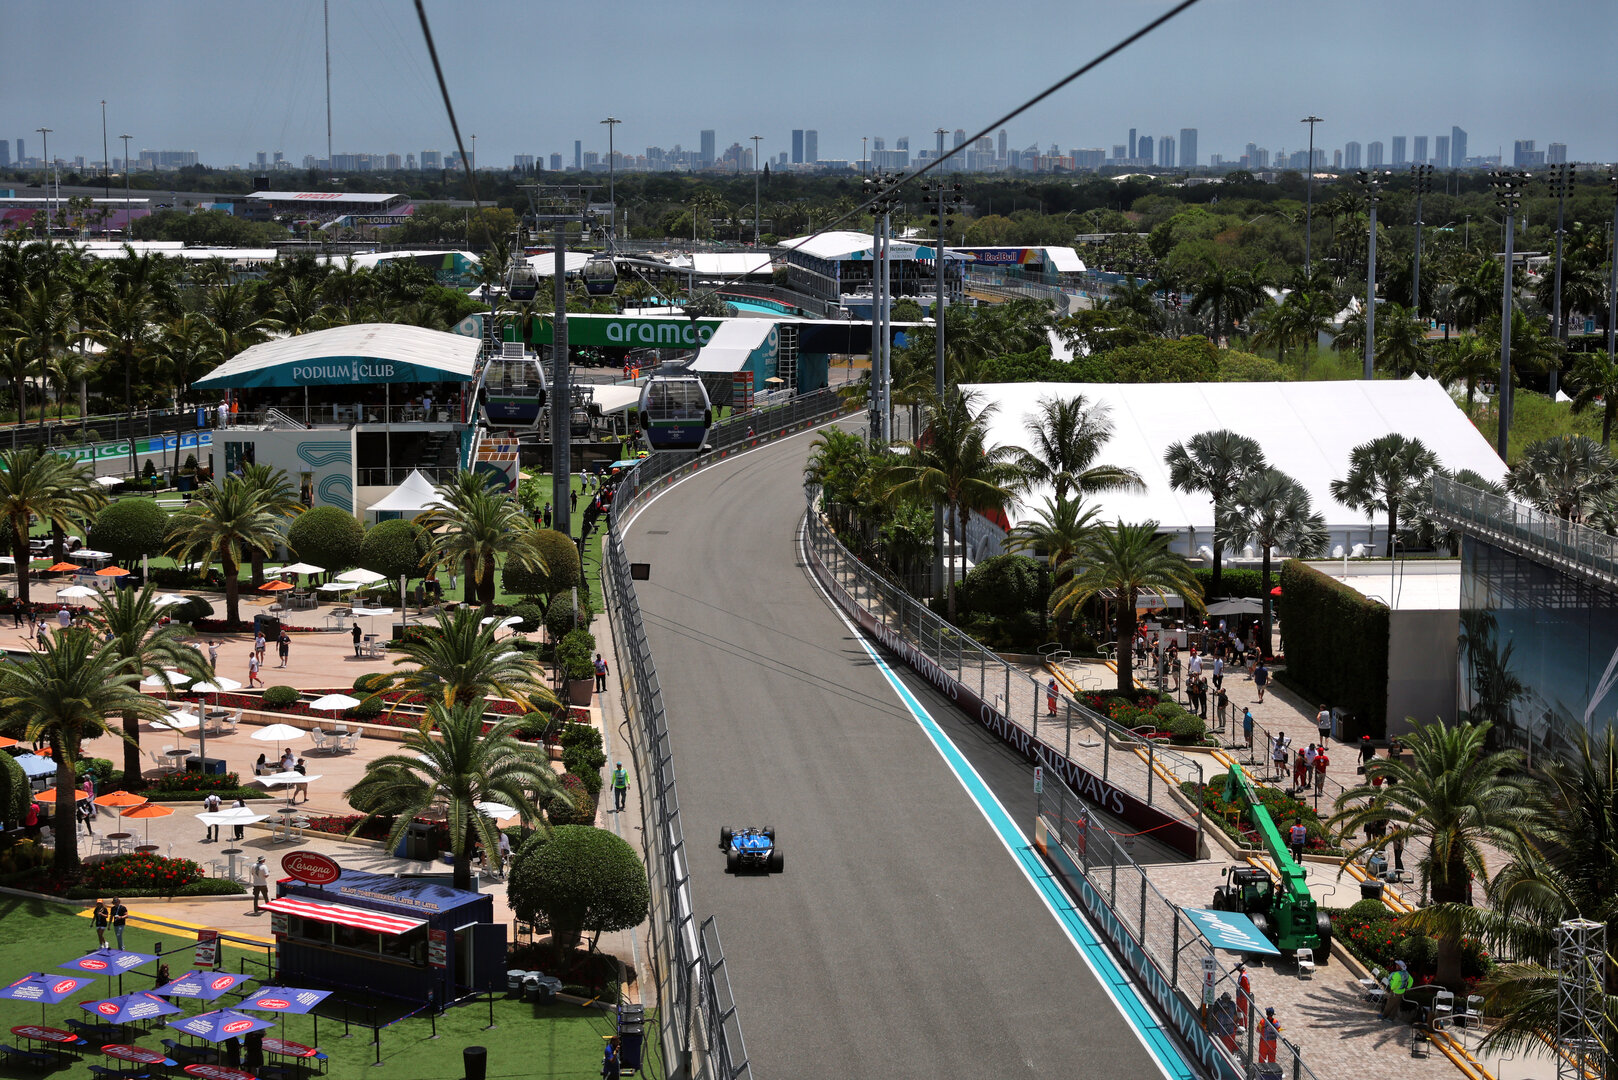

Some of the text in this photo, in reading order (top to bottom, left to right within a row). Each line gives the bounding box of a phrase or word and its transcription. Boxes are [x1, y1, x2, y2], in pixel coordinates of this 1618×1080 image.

[369, 216, 392, 224] LOUIS
[985, 252, 1017, 262] Red Bull
[606, 322, 714, 344] aramco
[768, 326, 779, 357] 9
[293, 364, 394, 379] PODIUM CLUB
[874, 622, 958, 700] QATAR AIRWAYS
[980, 703, 1124, 814] QATAR AIRWAYS
[288, 857, 332, 876] Lasagna
[1082, 881, 1222, 1080] QATAR AIRWAYS
